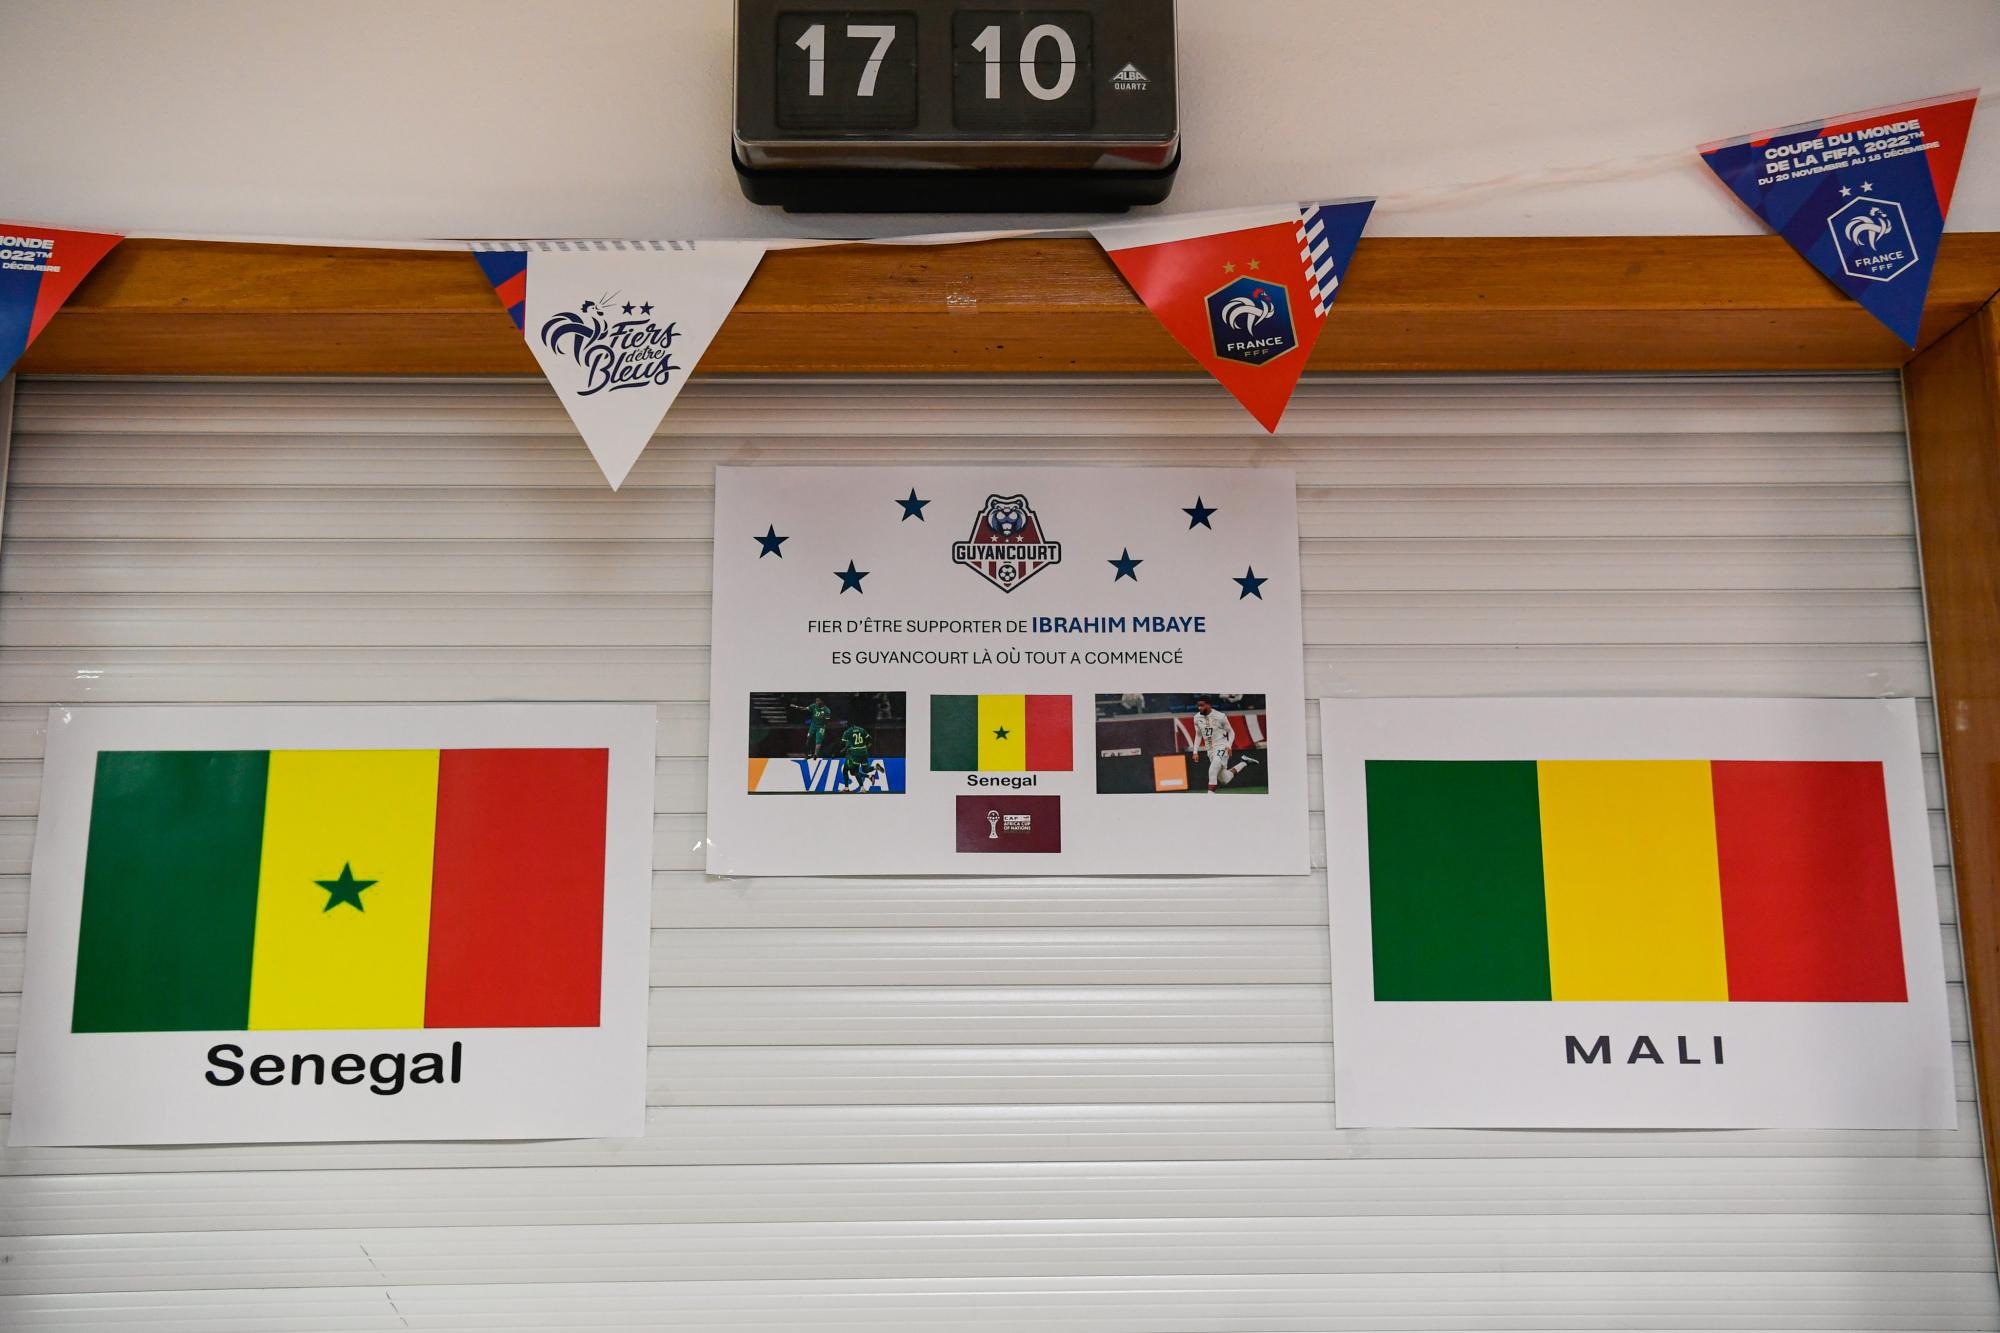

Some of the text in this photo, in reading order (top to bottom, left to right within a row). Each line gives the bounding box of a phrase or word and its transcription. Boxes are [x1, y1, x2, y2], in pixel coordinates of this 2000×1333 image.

[795, 24, 1076, 100] 17 10
[1112, 71, 1147, 81] ALBA
[1114, 82, 1147, 90] QUARTZ
[1765, 119, 1920, 160] COUPE DU MONDE
[1758, 176, 1773, 186] DU
[1775, 174, 1790, 182] 20
[1791, 160, 1849, 179] NOVEMBRE
[1852, 157, 1866, 166] AU
[1884, 141, 1940, 159] DÉCEMBRE
[1766, 161, 1790, 174] DE
[1793, 154, 1819, 168] LA
[1822, 146, 1860, 163] FIFA
[1855, 250, 1904, 267] FRANCE
[609, 319, 682, 349] Fiers
[1227, 336, 1283, 352] FRANCE
[577, 345, 681, 396] Bleus
[956, 545, 1057, 560] GUYANCOURT
[808, 620, 843, 633] FIER
[906, 619, 1002, 633] SUPPORTER
[1006, 620, 1028, 633] DE
[1032, 616, 1126, 633] IBRAHIM
[1132, 616, 1206, 633] MBAYE
[832, 646, 1184, 665] ES GUYANCOURT LÀ OÙ TOUT A COMMENCÉ
[852, 732, 864, 745] 26
[1204, 727, 1213, 737] 27
[967, 774, 1037, 789] Senegal
[1565, 1035, 1724, 1065] MALI
[205, 1041, 462, 1096] Senegal
